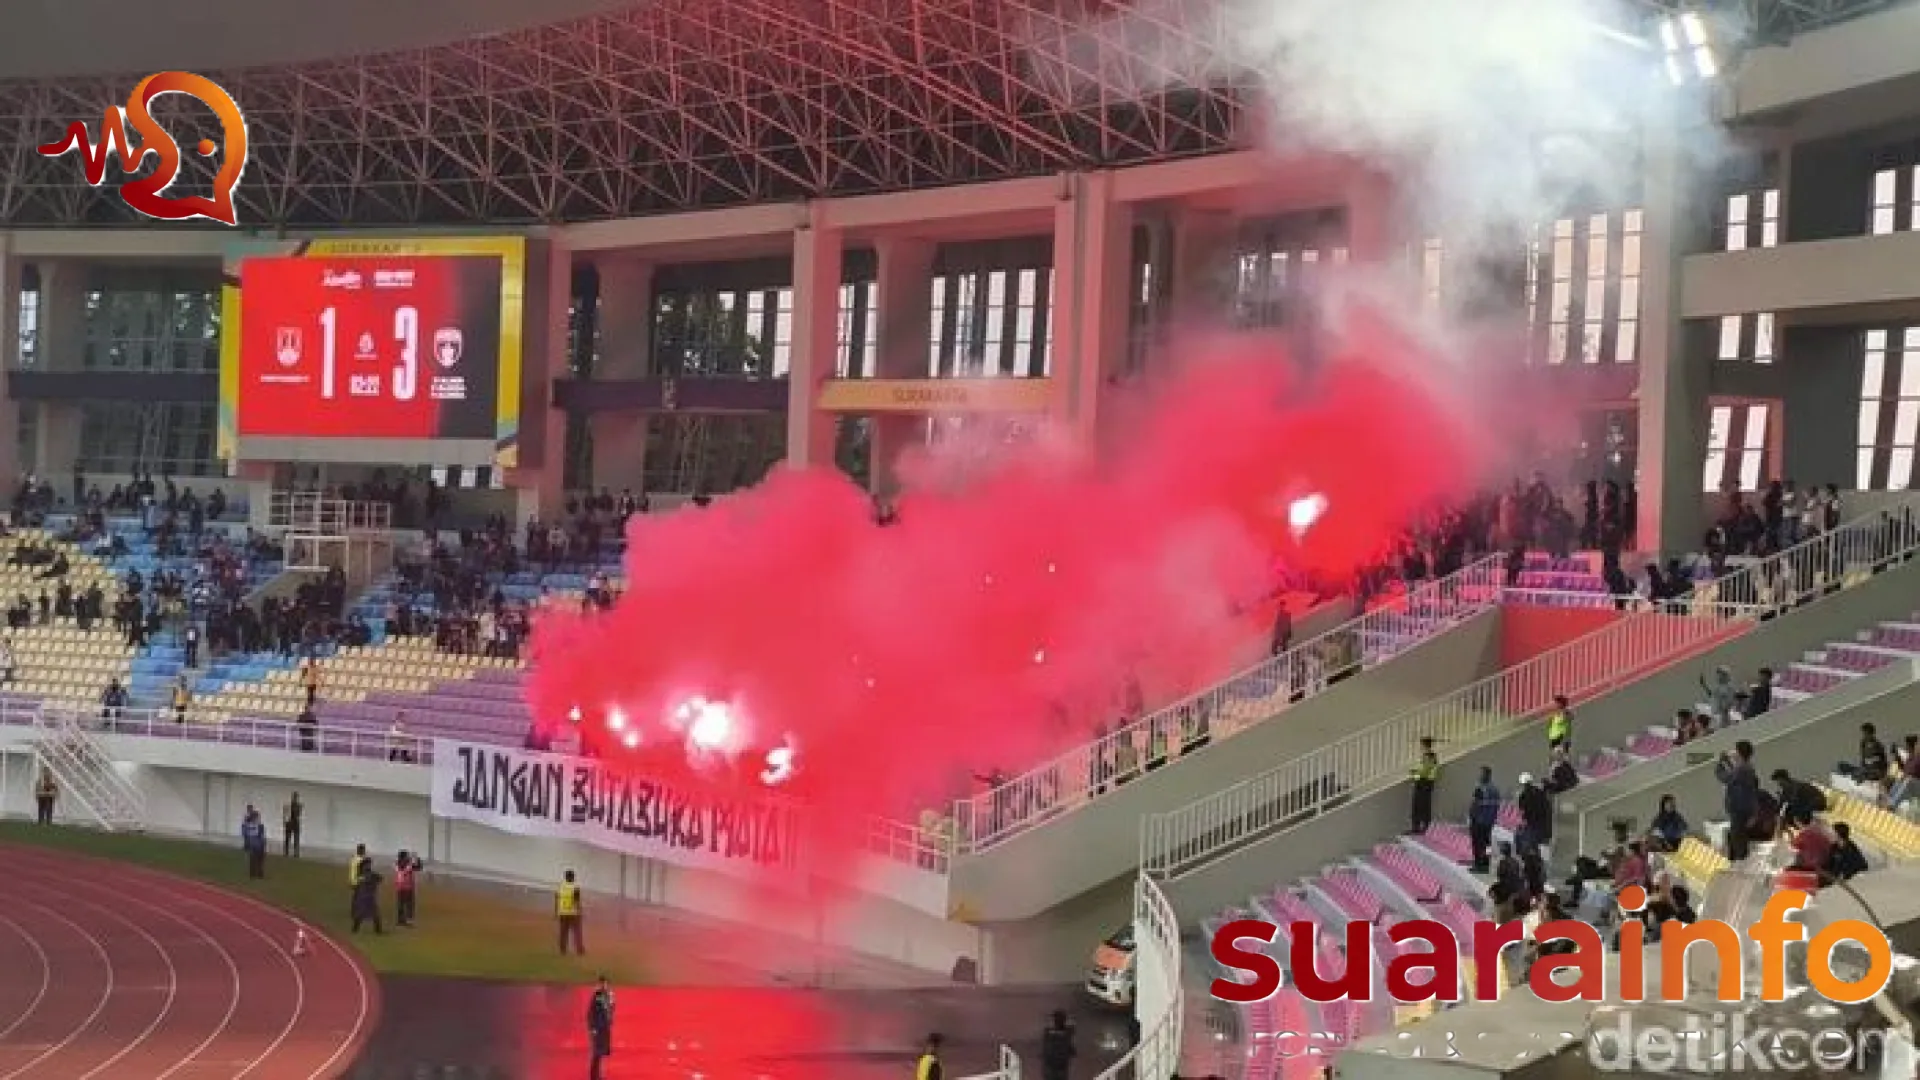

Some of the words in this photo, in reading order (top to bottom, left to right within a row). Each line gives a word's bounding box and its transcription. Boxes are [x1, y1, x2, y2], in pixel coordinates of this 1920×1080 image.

[318, 306, 336, 400] 1
[392, 306, 418, 400] 3
[453, 746, 563, 822] JANGAN
